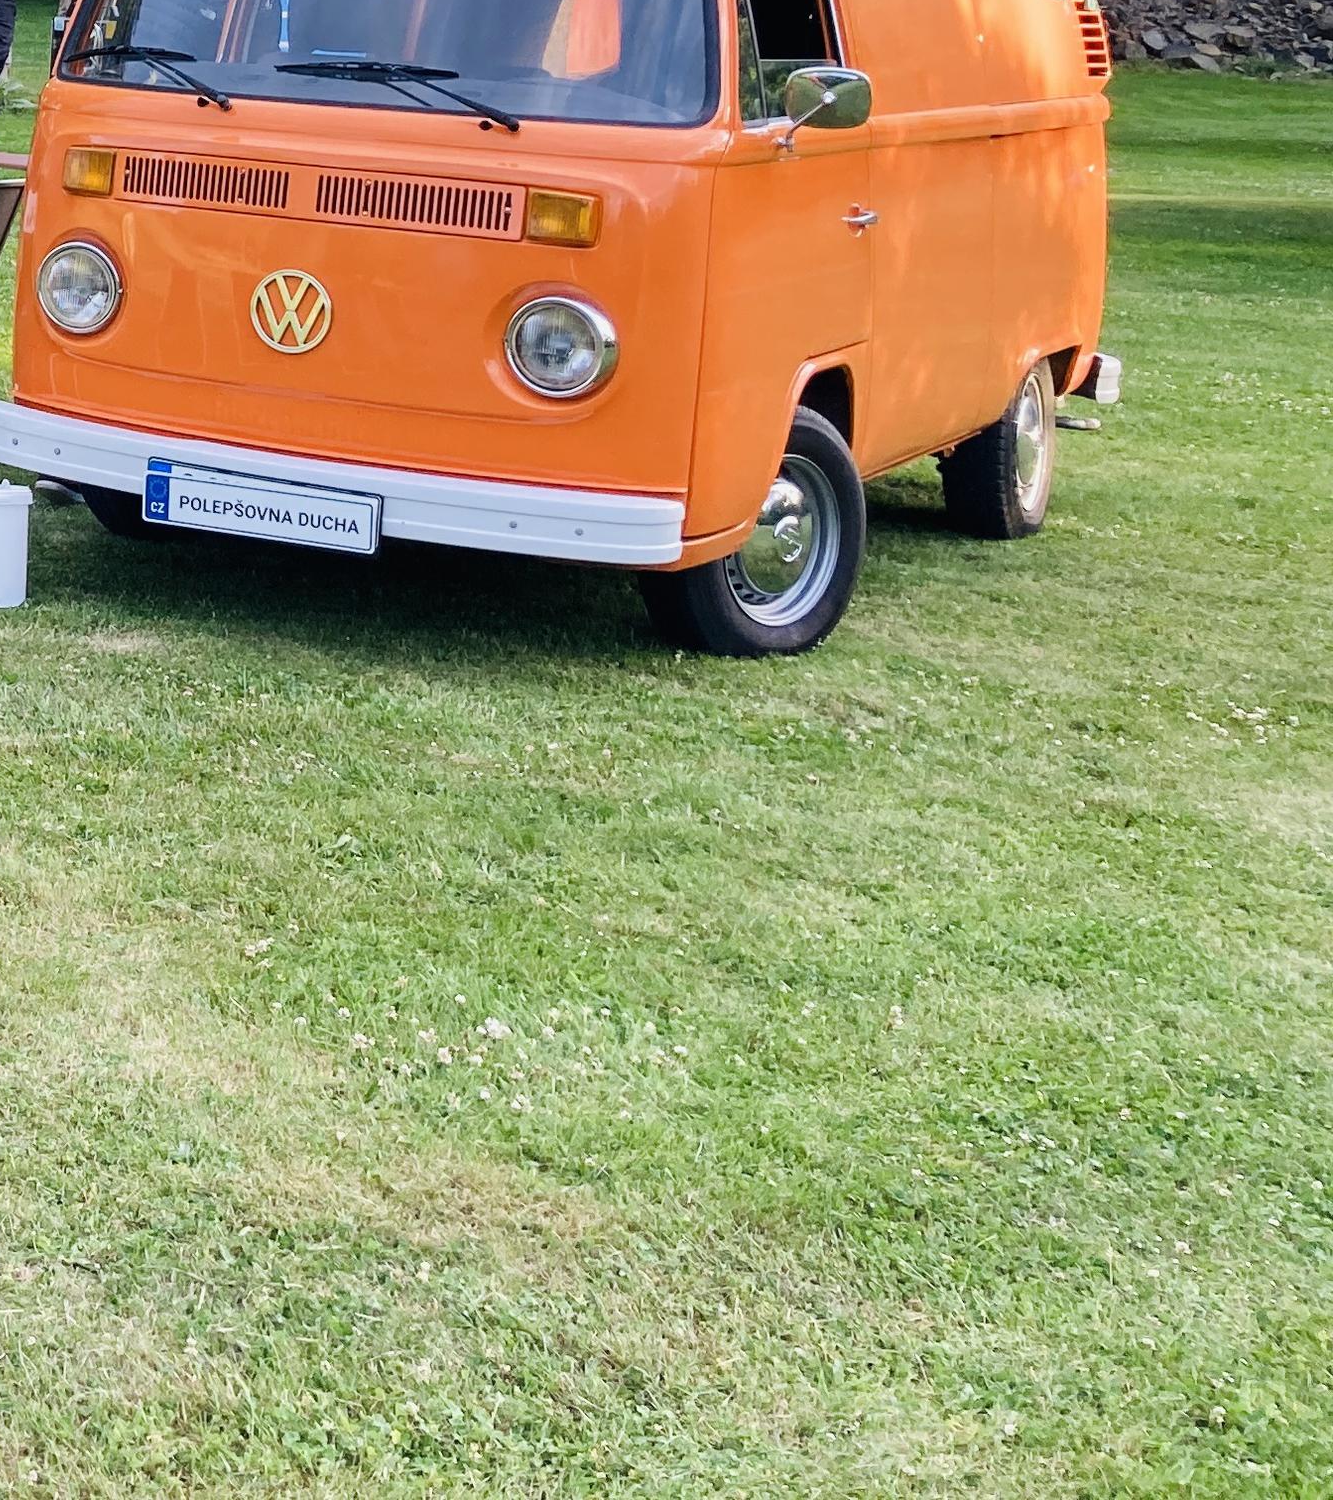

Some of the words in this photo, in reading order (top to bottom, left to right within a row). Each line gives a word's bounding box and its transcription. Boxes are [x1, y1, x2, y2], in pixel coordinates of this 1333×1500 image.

[253, 272, 328, 350] VW
[150, 501, 165, 514] CZ
[179, 495, 293, 525] POLEPŠOVNA
[298, 512, 360, 535] DUCHA
